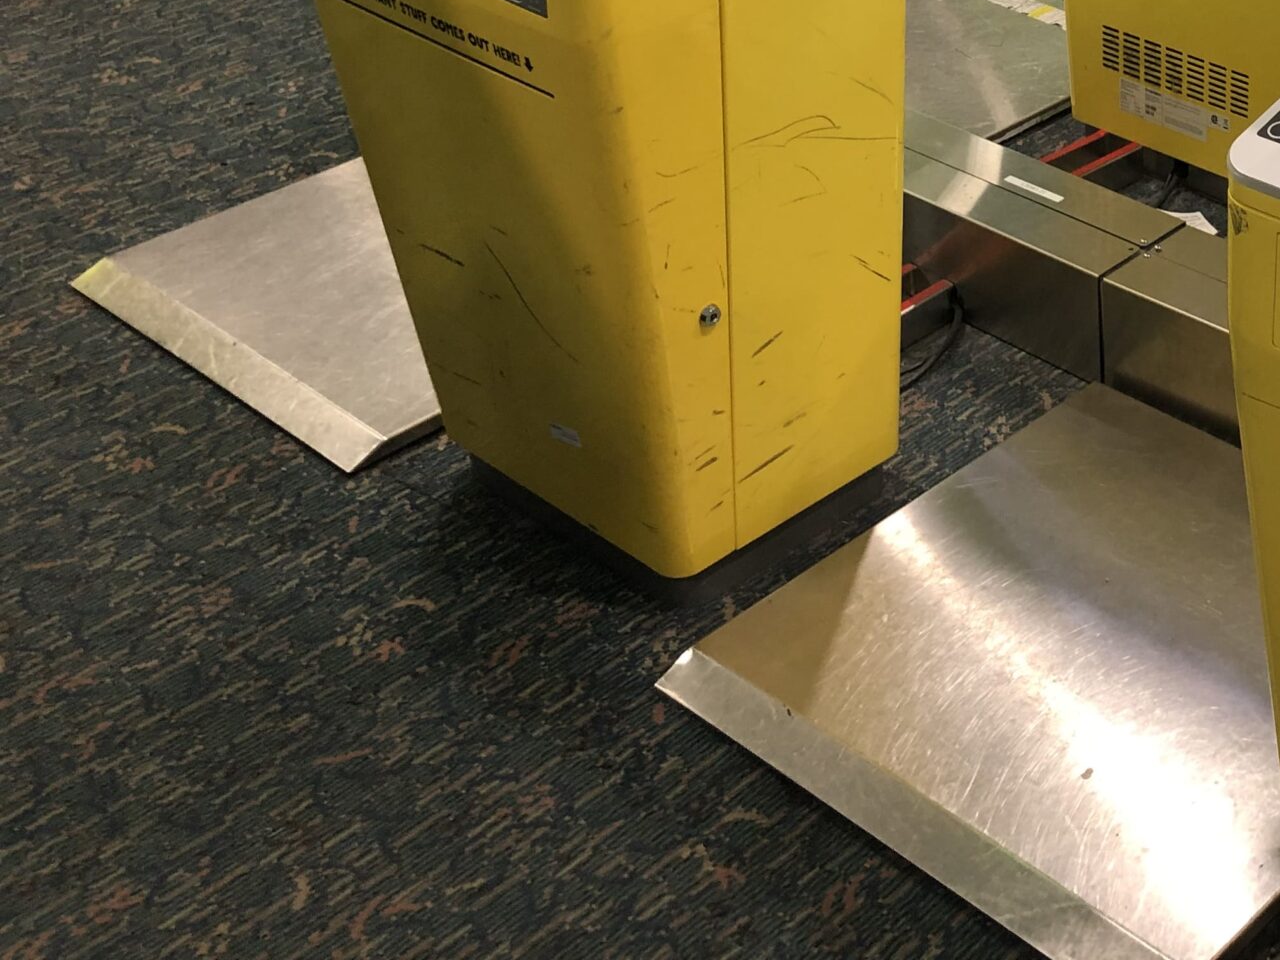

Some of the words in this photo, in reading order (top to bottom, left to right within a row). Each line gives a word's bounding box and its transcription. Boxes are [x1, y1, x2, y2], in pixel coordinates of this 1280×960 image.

[400, 3, 427, 24] STUFF
[431, 16, 465, 42] COMES
[468, 33, 490, 52] OUT
[493, 44, 521, 68] HERE!
